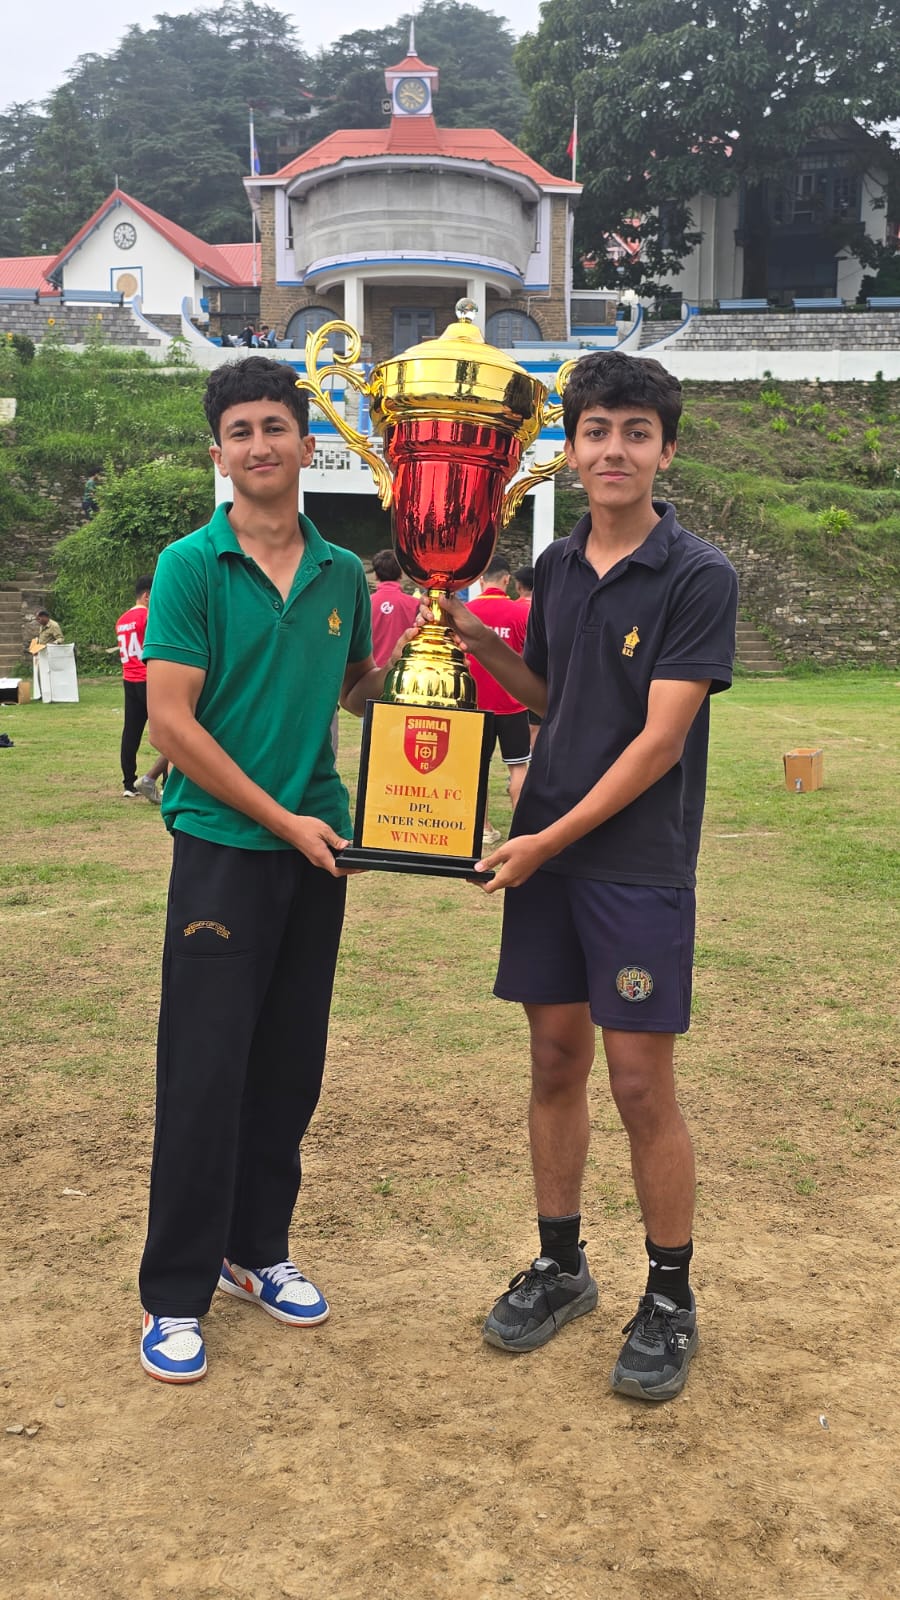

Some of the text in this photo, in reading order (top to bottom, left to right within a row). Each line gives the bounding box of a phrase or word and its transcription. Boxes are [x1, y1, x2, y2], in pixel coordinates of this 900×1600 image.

[117, 632, 143, 664] 34
[407, 718, 448, 733] SHIMLA
[420, 762, 429, 770] FC
[385, 784, 462, 801] SHIMLA FC
[409, 802, 433, 814] DPL
[377, 814, 466, 831] INTER SCHOOL
[390, 830, 449, 847] WINNER
